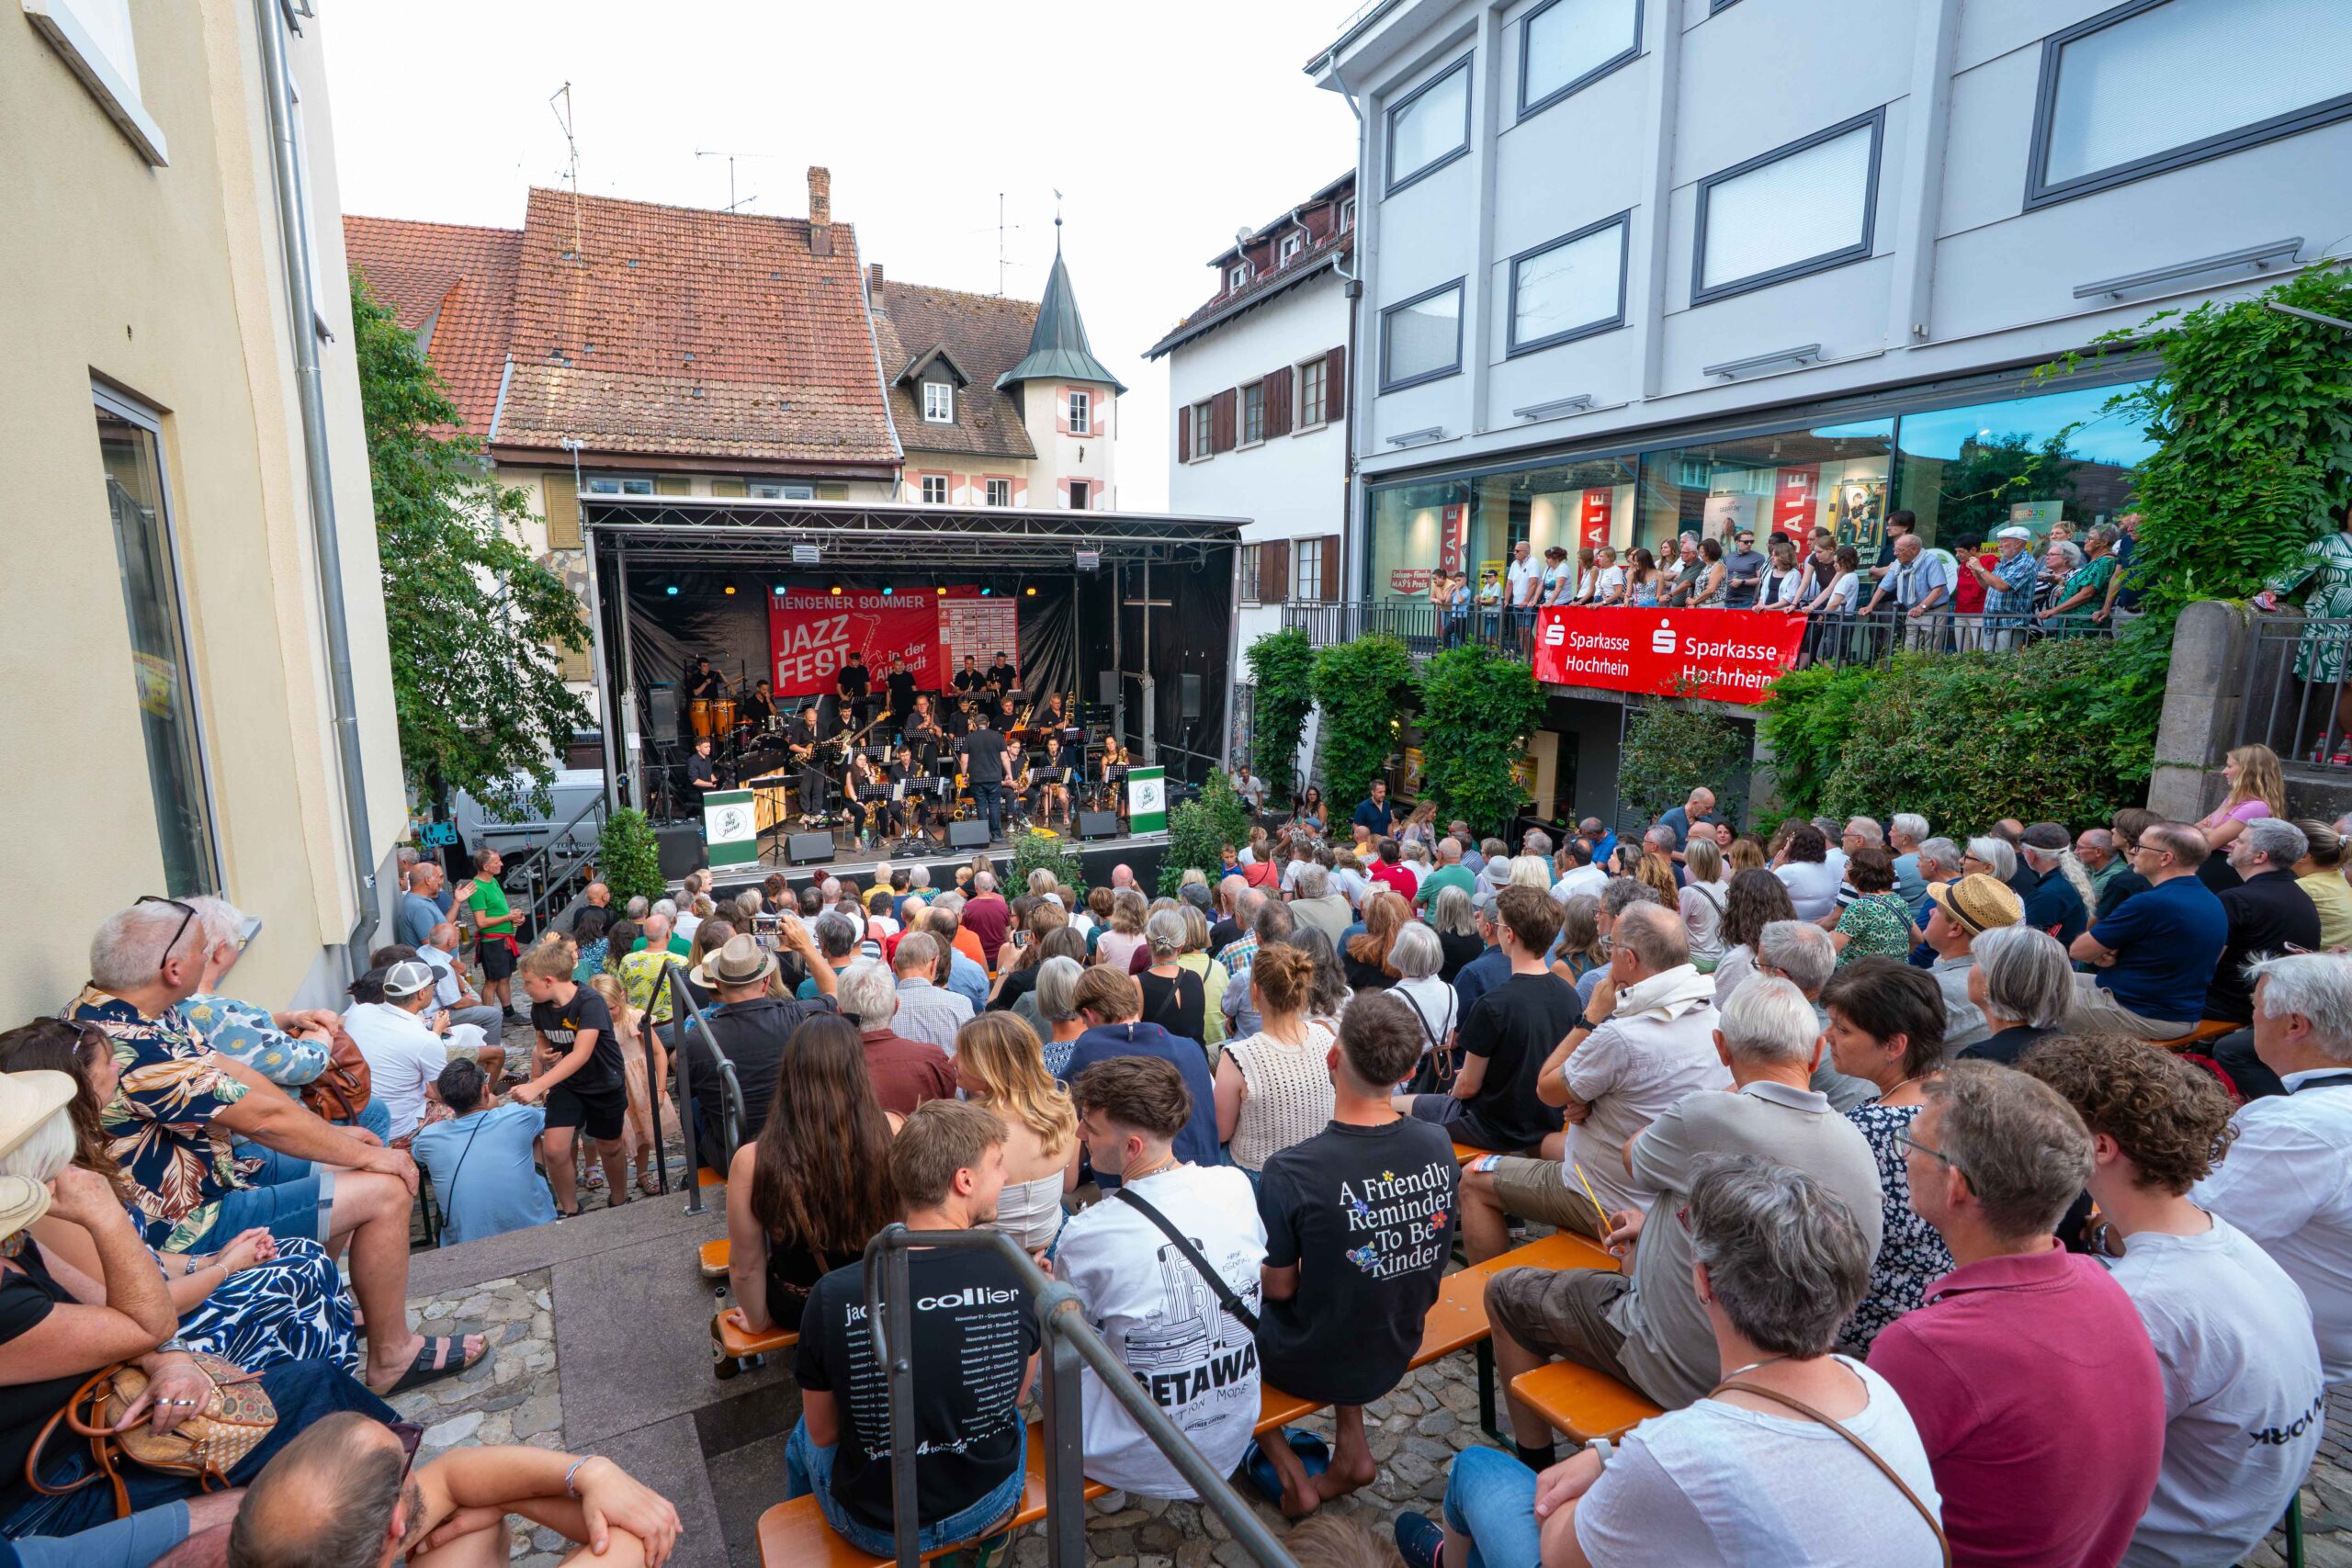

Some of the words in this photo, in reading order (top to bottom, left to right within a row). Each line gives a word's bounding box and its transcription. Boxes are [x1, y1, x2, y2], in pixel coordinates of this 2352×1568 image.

[1445, 510, 1457, 566] SALE
[1412, 580, 1427, 588] Preis
[772, 596, 854, 610] TIENGENER
[859, 595, 925, 609] SOMMER
[778, 614, 849, 658] JAZZ
[1569, 631, 1630, 651] Sparkasse
[888, 650, 900, 661] in
[905, 643, 926, 657] der
[1684, 637, 1778, 661] Sparkasse
[778, 643, 850, 688] FEST
[1566, 655, 1629, 677] Hochrhein
[1682, 664, 1772, 689] Hochrhein
[1339, 1180, 1357, 1205] A
[1363, 1162, 1450, 1202] Friendly
[1346, 1190, 1453, 1232] Reminder
[1375, 1229, 1402, 1253] To
[1408, 1222, 1436, 1246] Be
[1369, 1243, 1442, 1278] Kinder
[917, 1287, 1019, 1311] collier
[1216, 1383, 1249, 1402] MODE
[1184, 1421, 1207, 1432] ANOTHER
